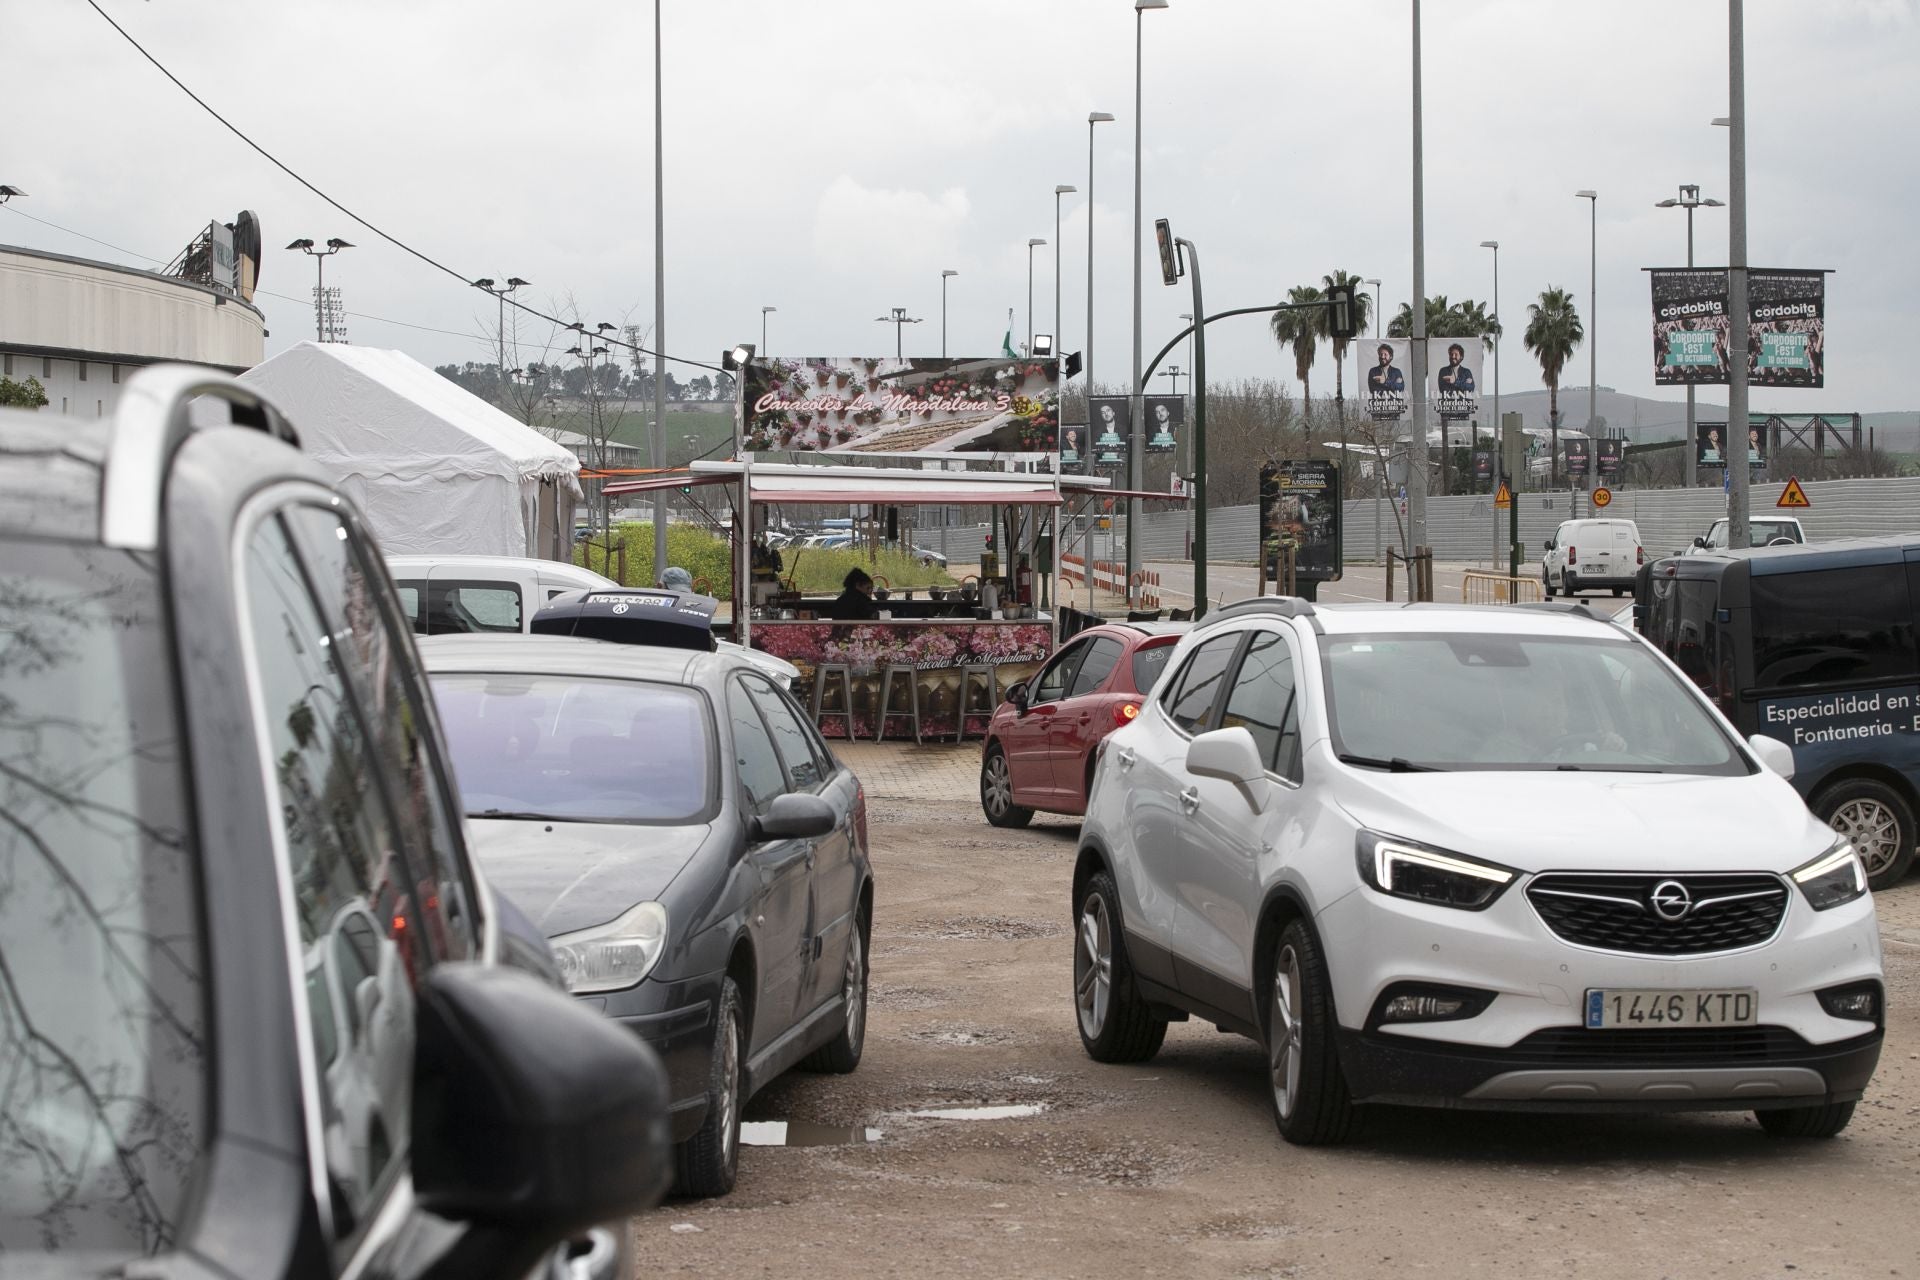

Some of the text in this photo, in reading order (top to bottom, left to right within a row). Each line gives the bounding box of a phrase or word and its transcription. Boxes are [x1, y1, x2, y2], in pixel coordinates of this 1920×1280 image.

[1660, 300, 1722, 317] cordobita
[1755, 303, 1816, 318] cordobita
[754, 393, 1010, 416] Caracoles La Magdalena 3
[1369, 397, 1403, 406] Córdoba
[1438, 397, 1473, 406] Córdoba
[1596, 493, 1608, 501] 30
[902, 649, 1046, 671] Cracoles La Magdalena 3
[1766, 693, 1881, 725] Especialidad
[1886, 695, 1909, 710] en
[1794, 719, 1893, 745] Fontaneria
[1612, 993, 1751, 1024] 1446 KTD
